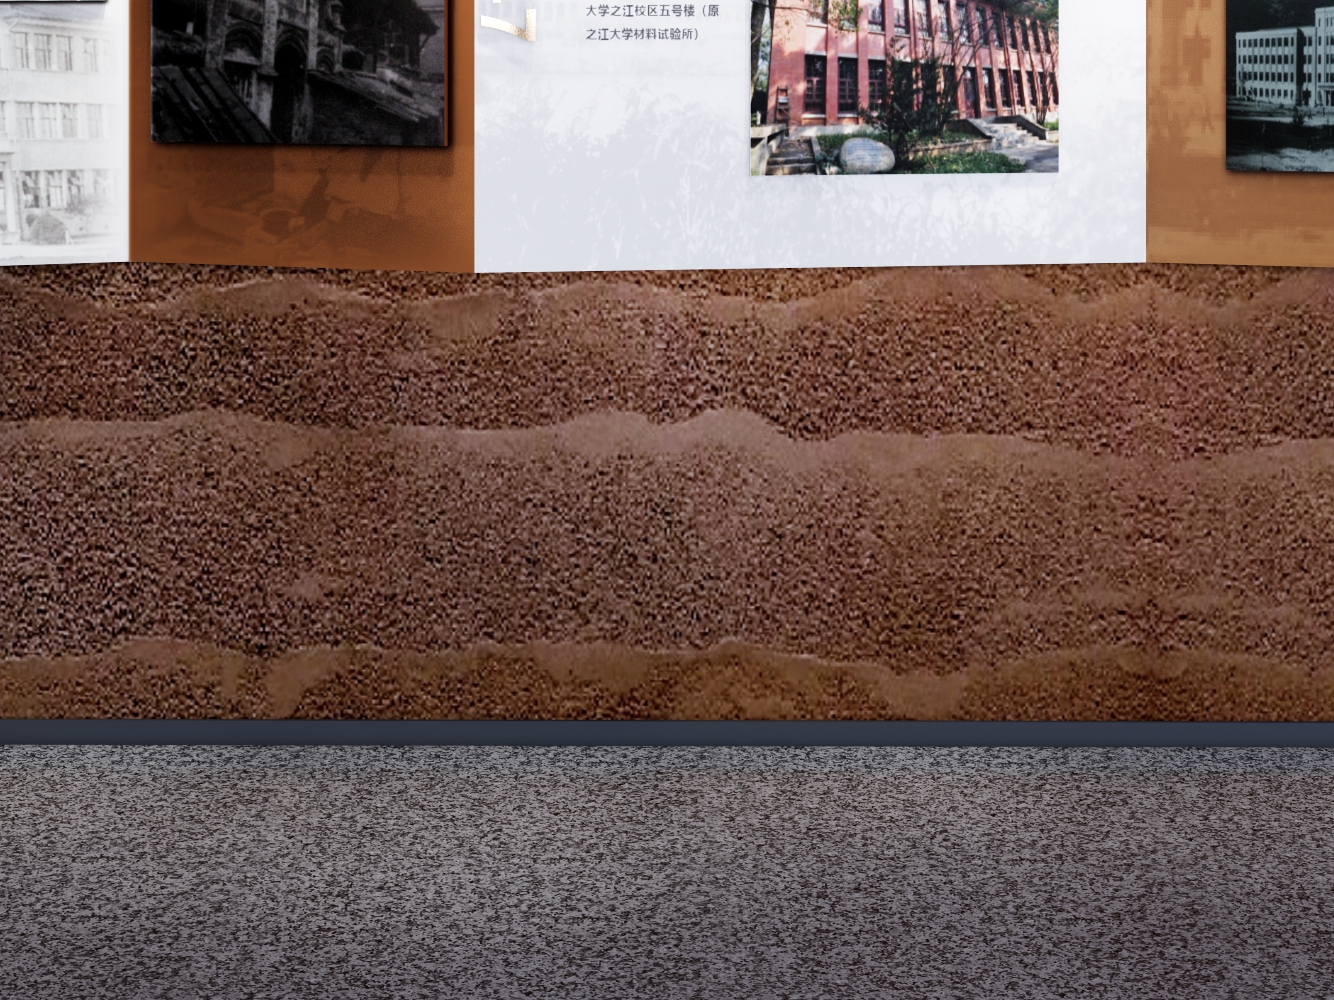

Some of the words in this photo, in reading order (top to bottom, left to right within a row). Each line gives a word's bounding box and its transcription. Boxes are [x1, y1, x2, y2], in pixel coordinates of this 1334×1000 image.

[586, 4, 720, 17] 大学之江校区五号楼（原
[586, 28, 699, 41] 之江大学材料试验所）
